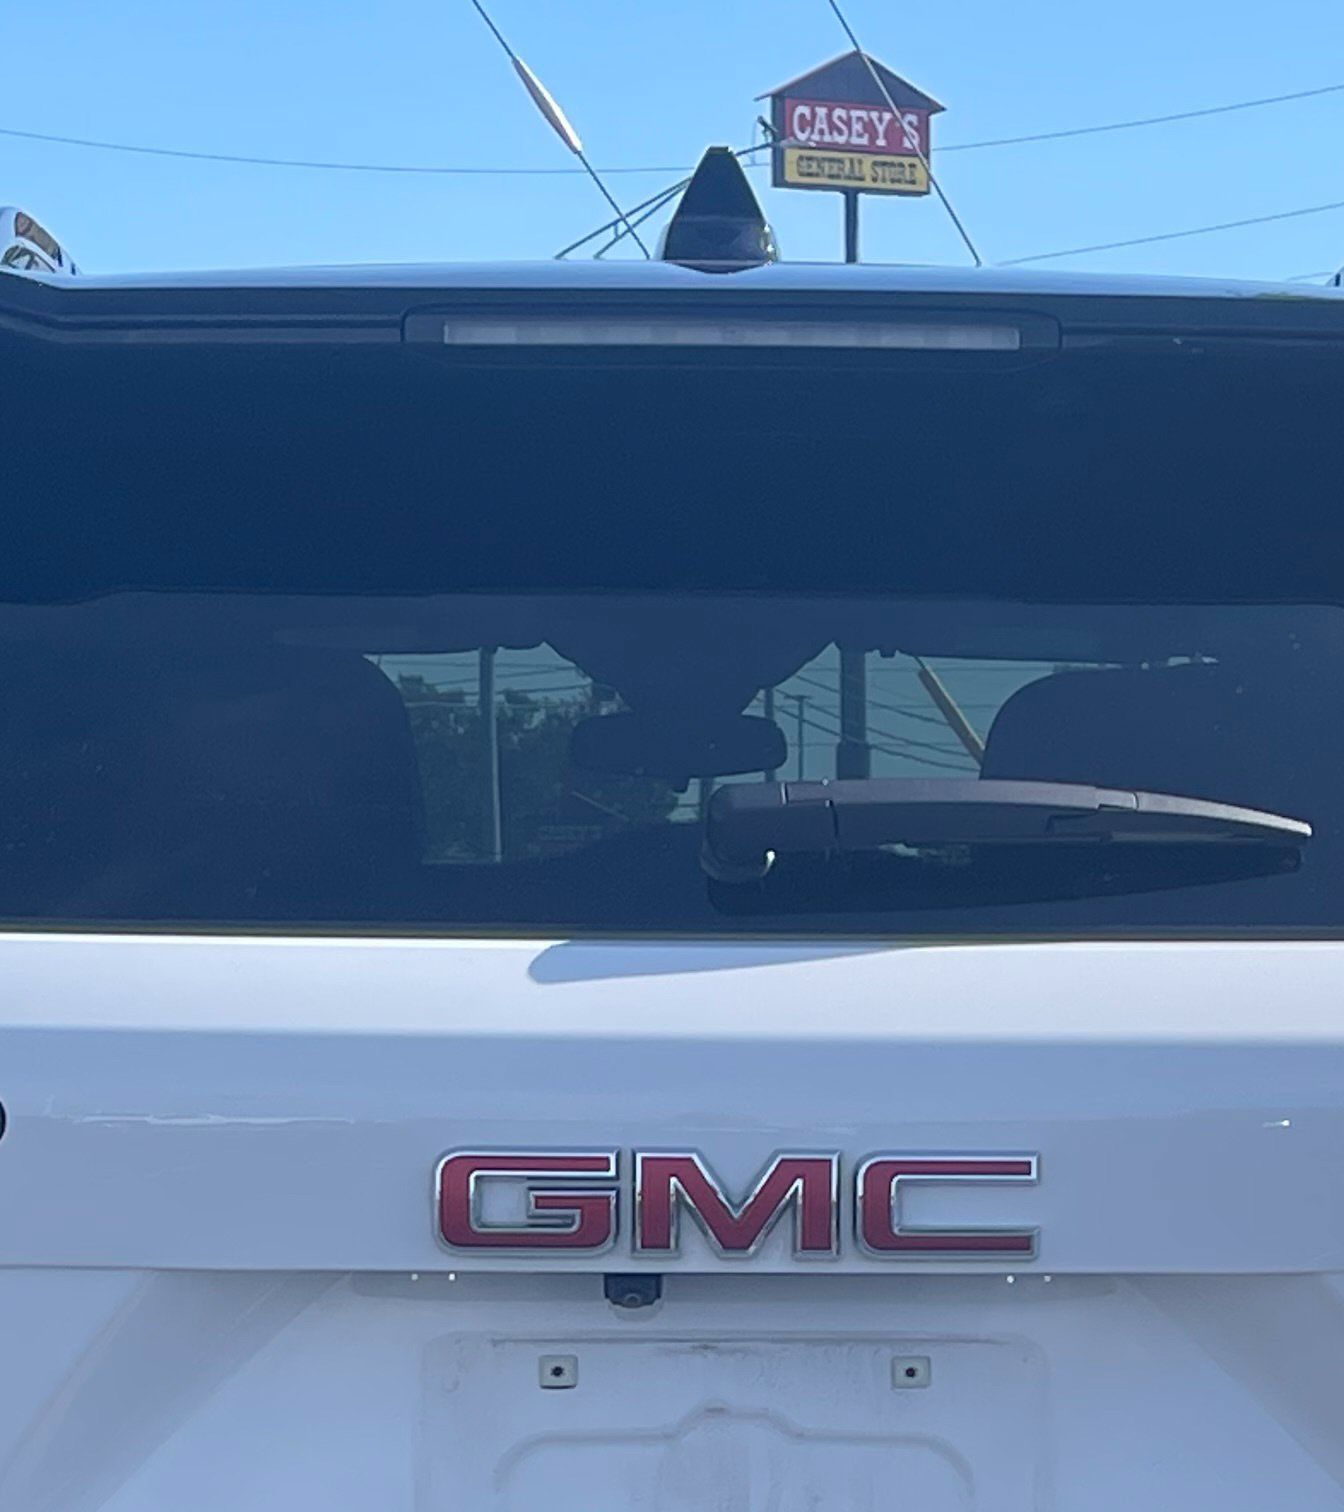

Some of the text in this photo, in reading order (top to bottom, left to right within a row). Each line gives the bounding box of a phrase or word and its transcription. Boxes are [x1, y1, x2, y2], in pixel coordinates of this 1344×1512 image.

[792, 105, 921, 149] CASEY'S
[797, 155, 917, 185] GENERAL STORE
[434, 1145, 1041, 1260] GMC
